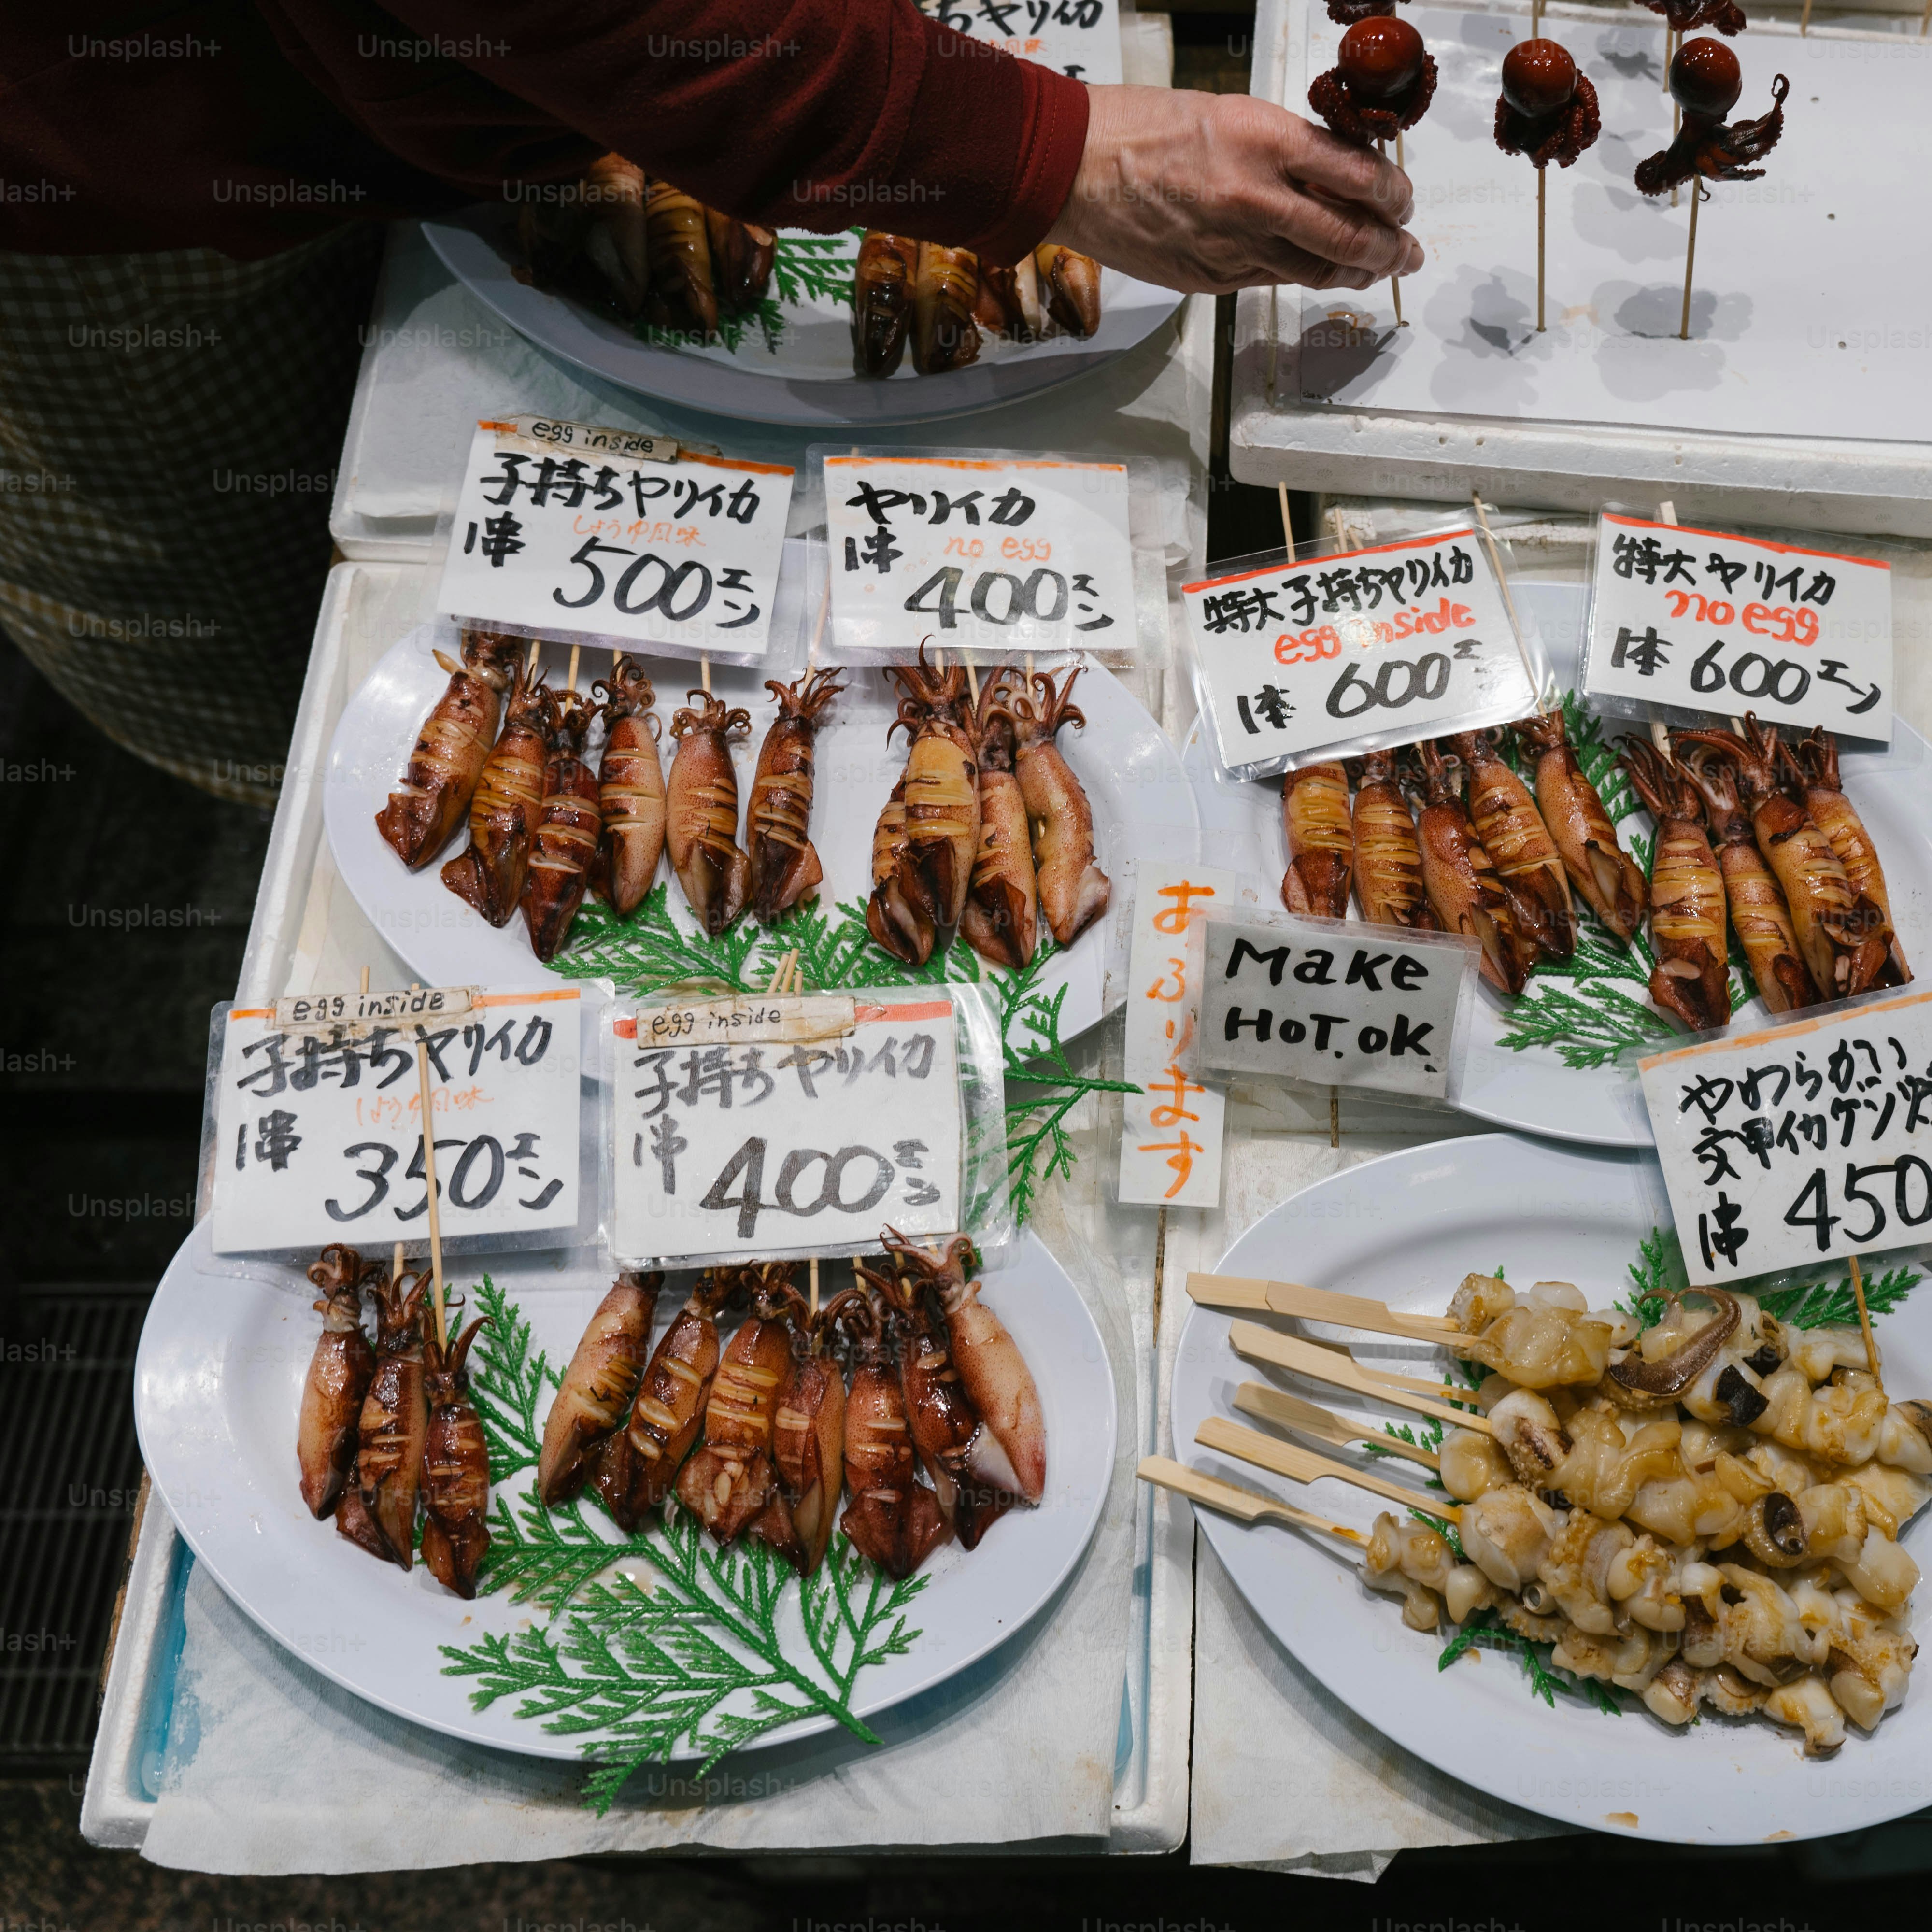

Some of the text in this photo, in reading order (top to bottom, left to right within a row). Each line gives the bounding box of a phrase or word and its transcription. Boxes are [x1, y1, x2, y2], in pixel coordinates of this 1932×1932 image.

[532, 421, 654, 453] egg inside
[943, 536, 1051, 562] no egg
[1664, 589, 1819, 647] no egg
[1274, 625, 1342, 665] egg
[292, 990, 445, 1021] egg inside
[652, 1007, 781, 1037] egg inside
